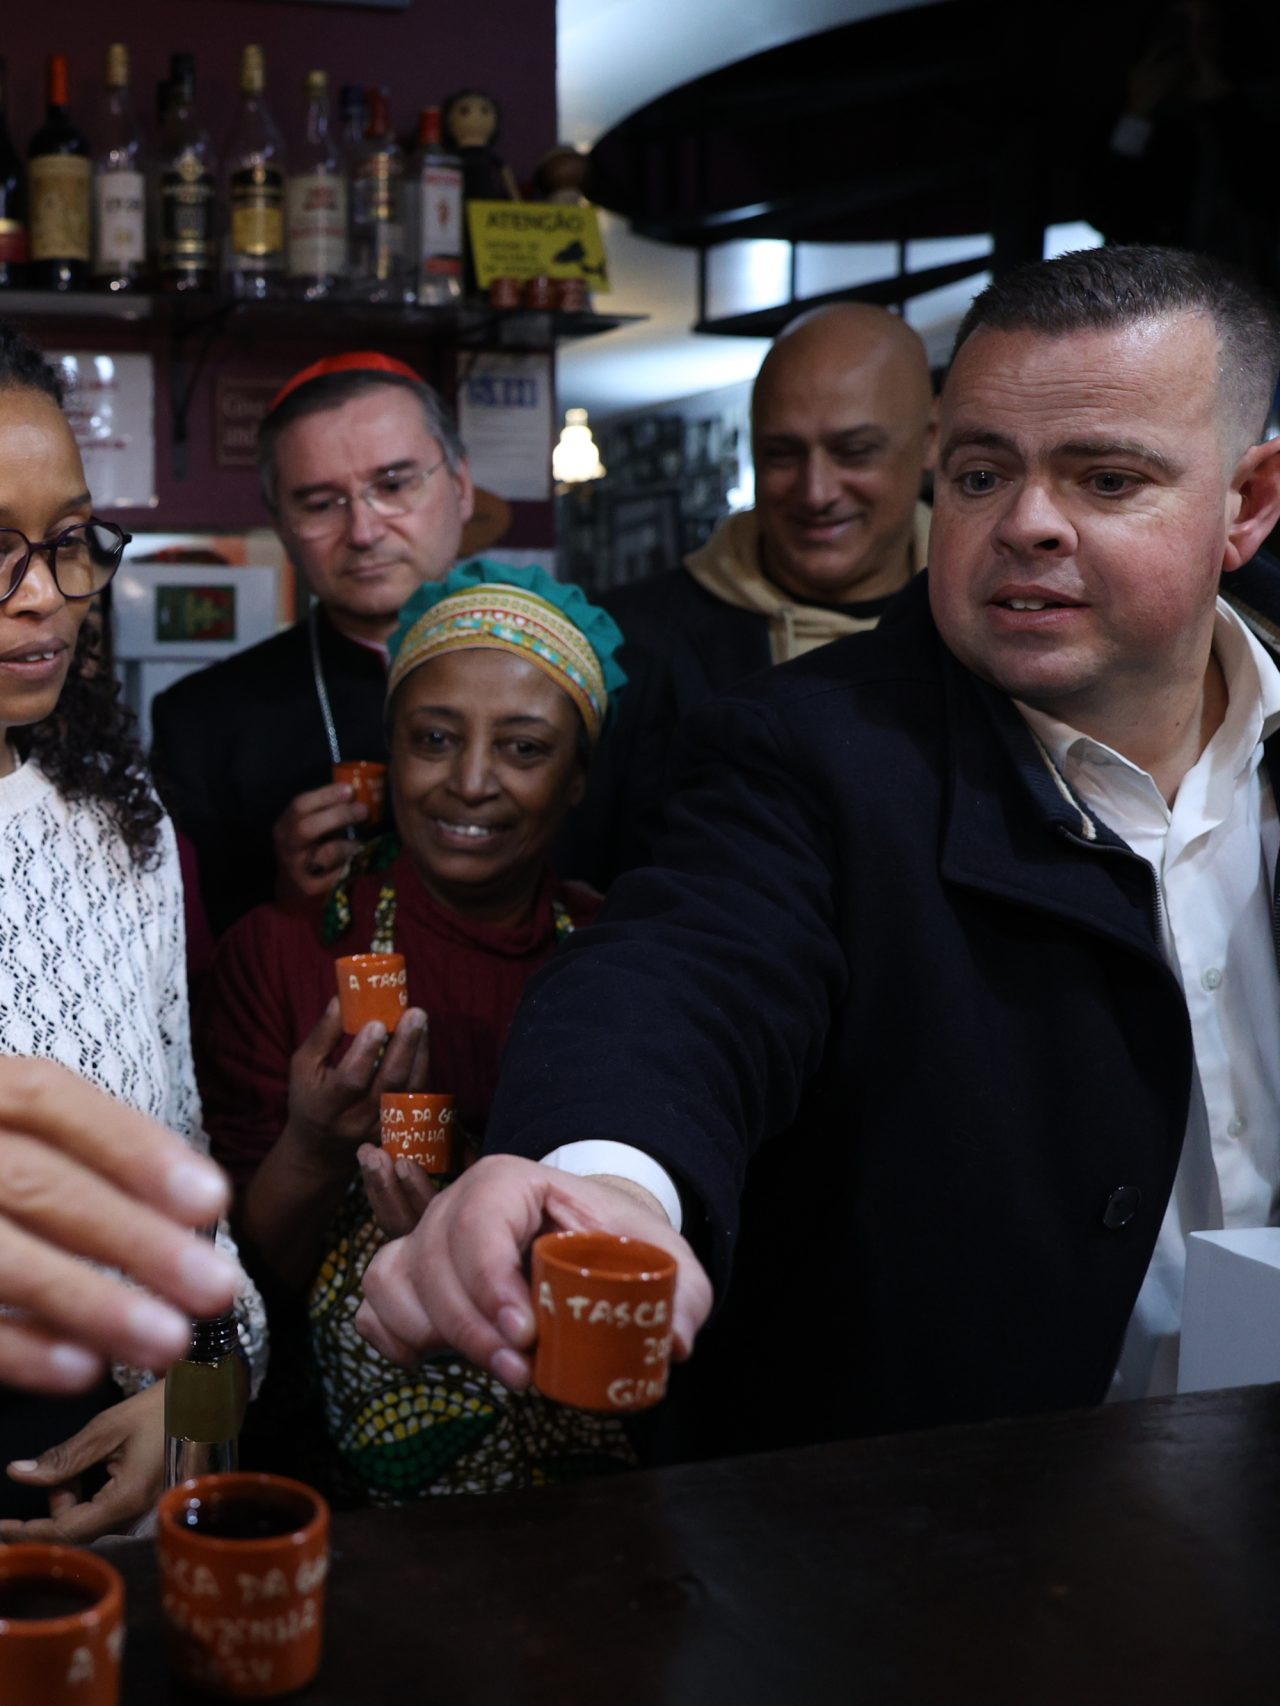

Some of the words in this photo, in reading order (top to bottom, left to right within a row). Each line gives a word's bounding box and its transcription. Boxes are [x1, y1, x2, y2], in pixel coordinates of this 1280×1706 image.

[486, 209, 584, 233] ATENÇÃO
[349, 974, 360, 991] A
[412, 1107, 433, 1123] DA
[539, 1281, 557, 1316] A
